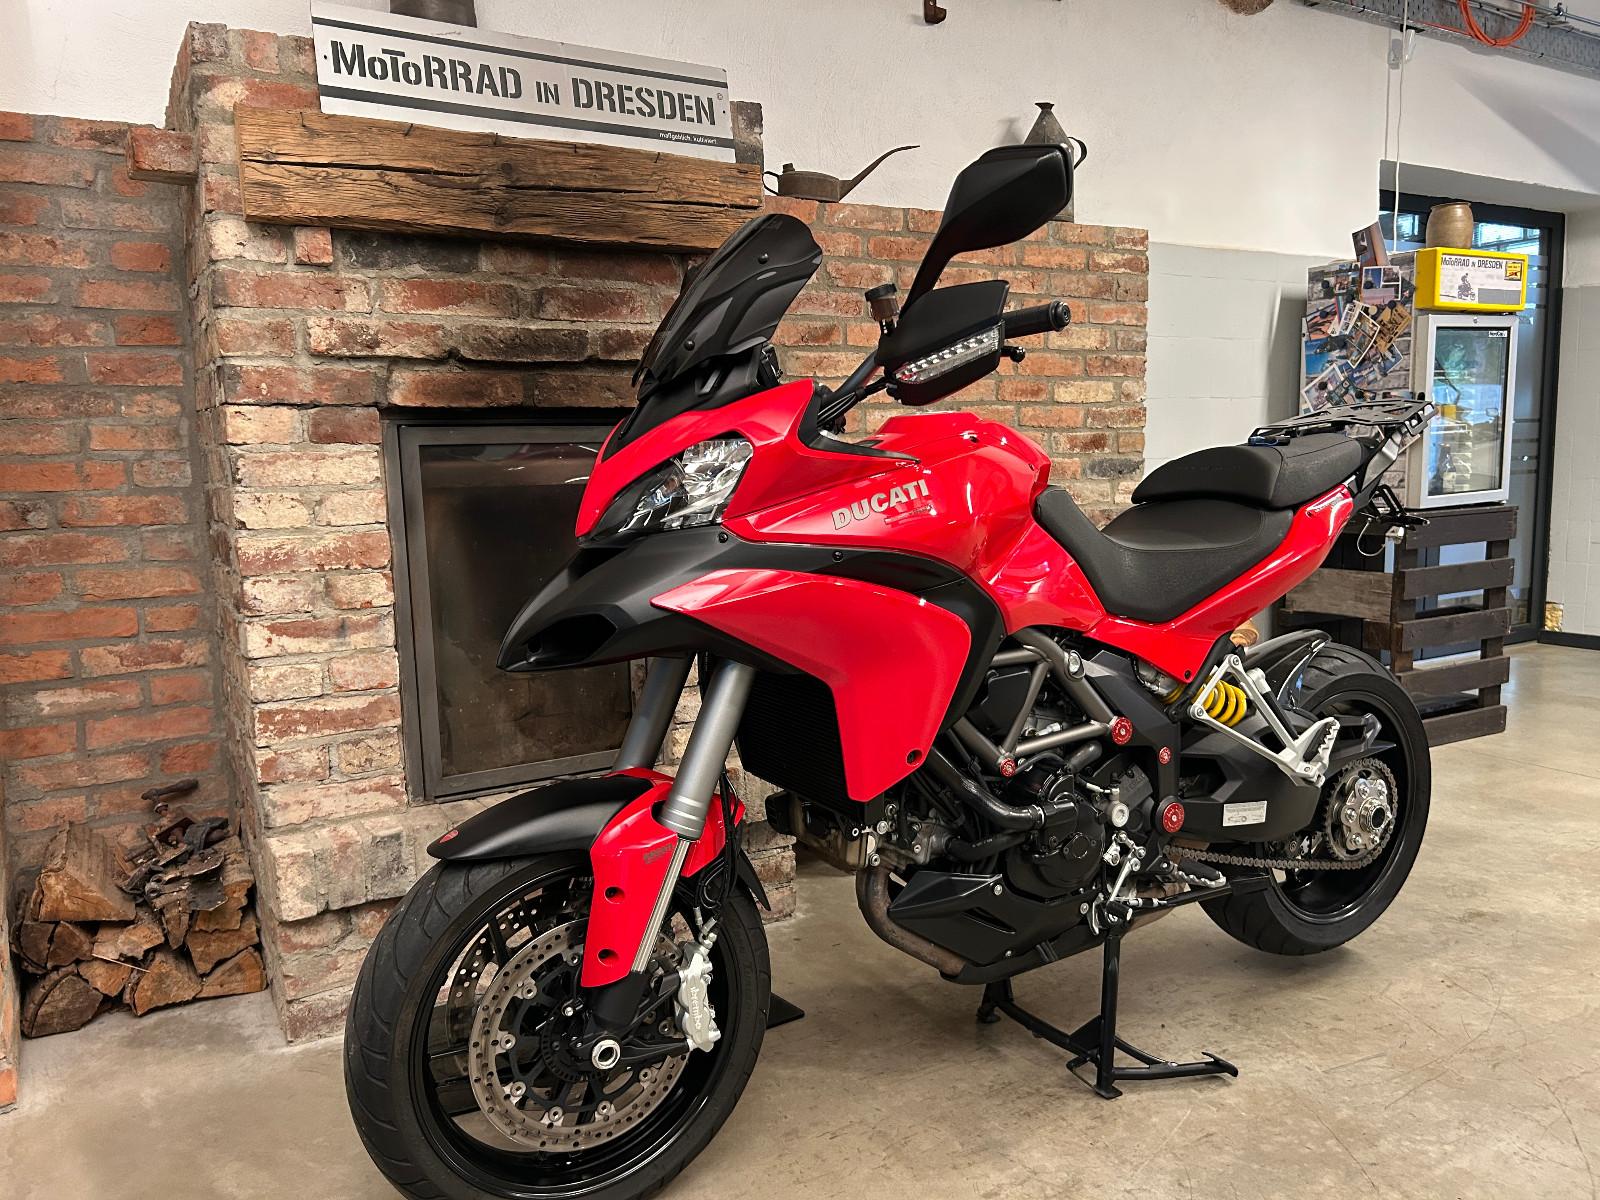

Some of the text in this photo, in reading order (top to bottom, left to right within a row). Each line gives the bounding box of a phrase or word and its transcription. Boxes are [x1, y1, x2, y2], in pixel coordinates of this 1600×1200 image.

[536, 81, 560, 105] IN
[572, 77, 717, 126] DRESDEN
[1477, 259, 1503, 270] DRESDEN
[831, 479, 930, 531] DUCATI
[690, 986, 702, 1030] brembo
